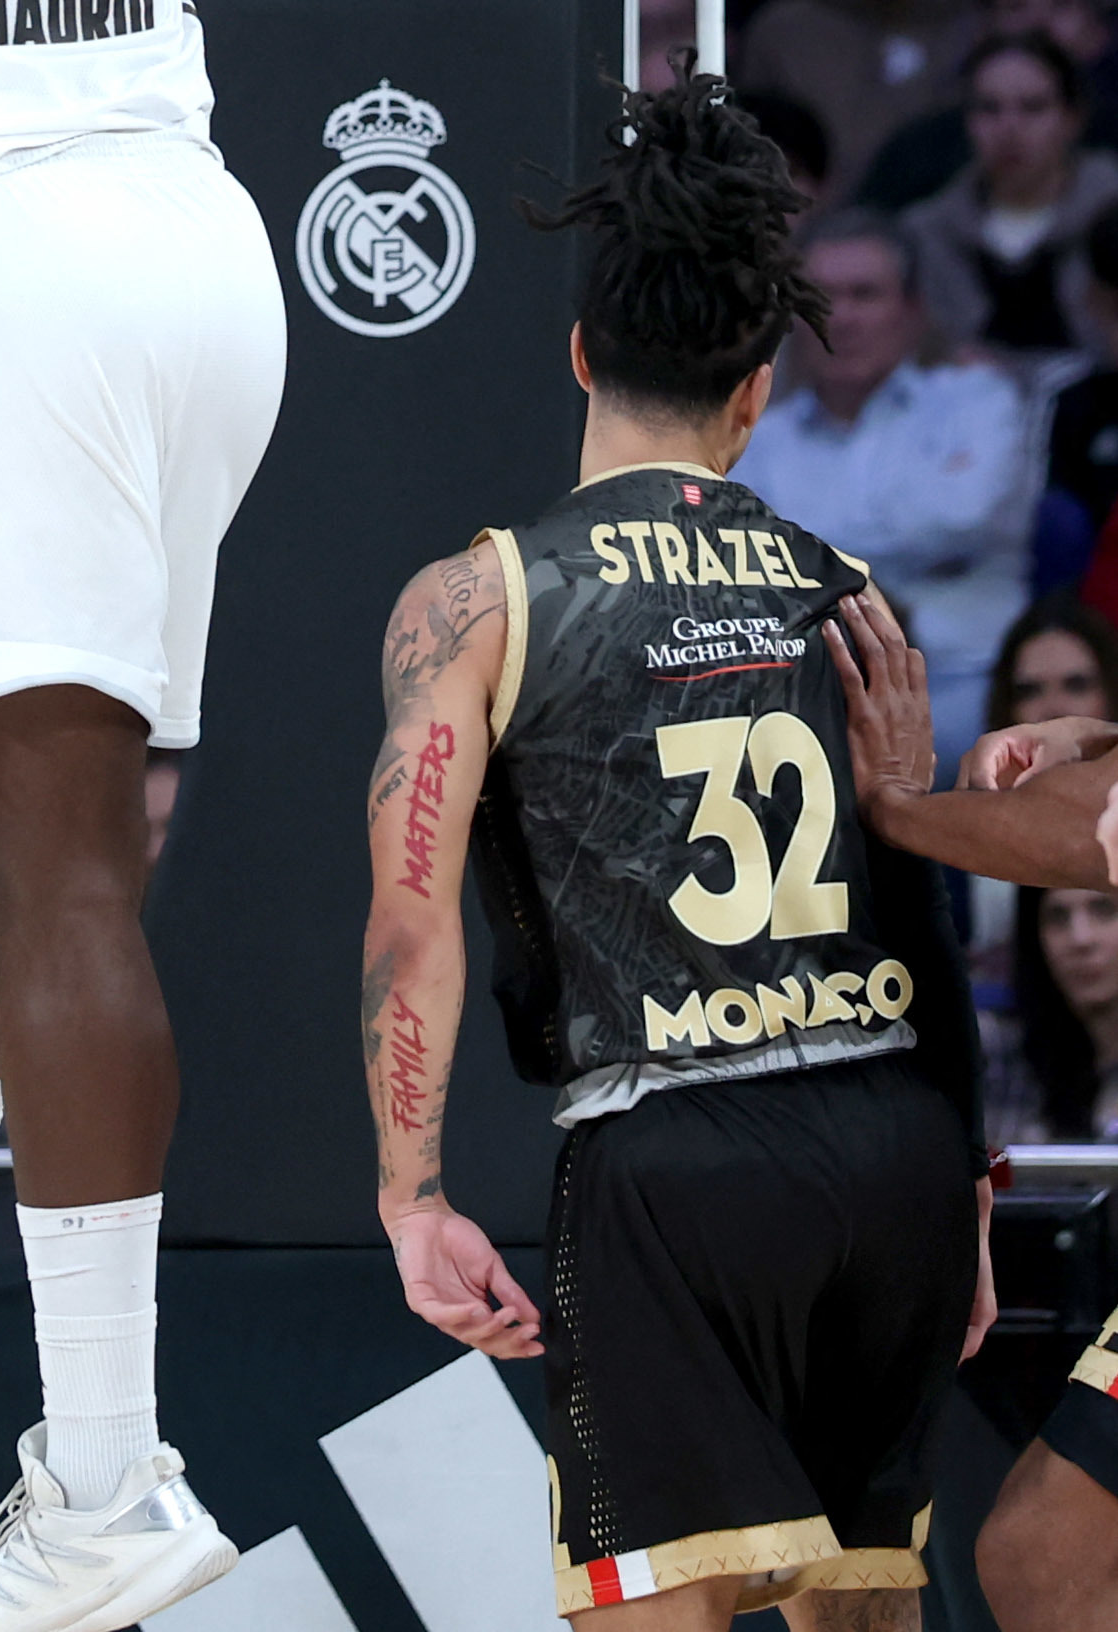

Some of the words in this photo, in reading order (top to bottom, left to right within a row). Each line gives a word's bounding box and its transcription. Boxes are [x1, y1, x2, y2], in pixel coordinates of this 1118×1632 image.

[590, 521, 823, 589] STRAZEL
[745, 633, 807, 658] PATOR
[396, 721, 457, 899] MATTERS
[655, 711, 849, 946] 32
[389, 991, 427, 1134] FAMILY
